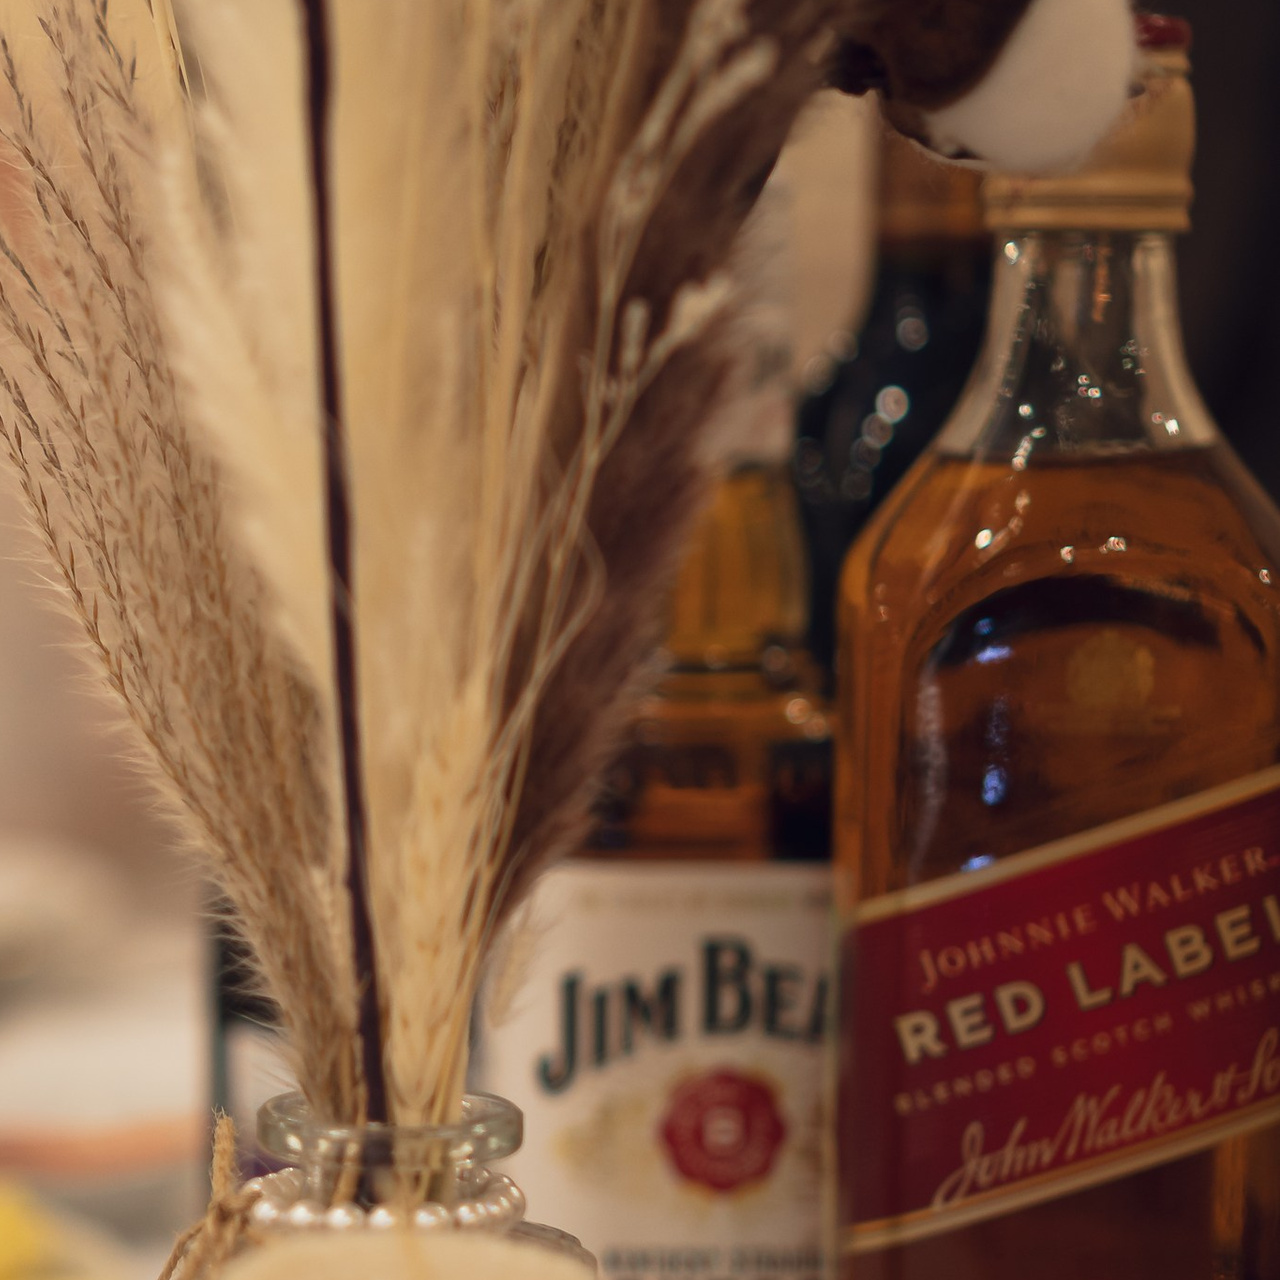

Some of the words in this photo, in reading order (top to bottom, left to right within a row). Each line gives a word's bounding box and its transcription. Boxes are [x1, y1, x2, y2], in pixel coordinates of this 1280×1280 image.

[920, 904, 1093, 995] JOHNNIE
[1102, 846, 1272, 920] WALKER
[537, 968, 680, 1097] JIM
[894, 980, 1046, 1065] RED
[894, 1056, 1037, 1116] BLENDED
[1050, 1013, 1173, 1069] SCOTCH
[930, 1118, 1056, 1211] John
